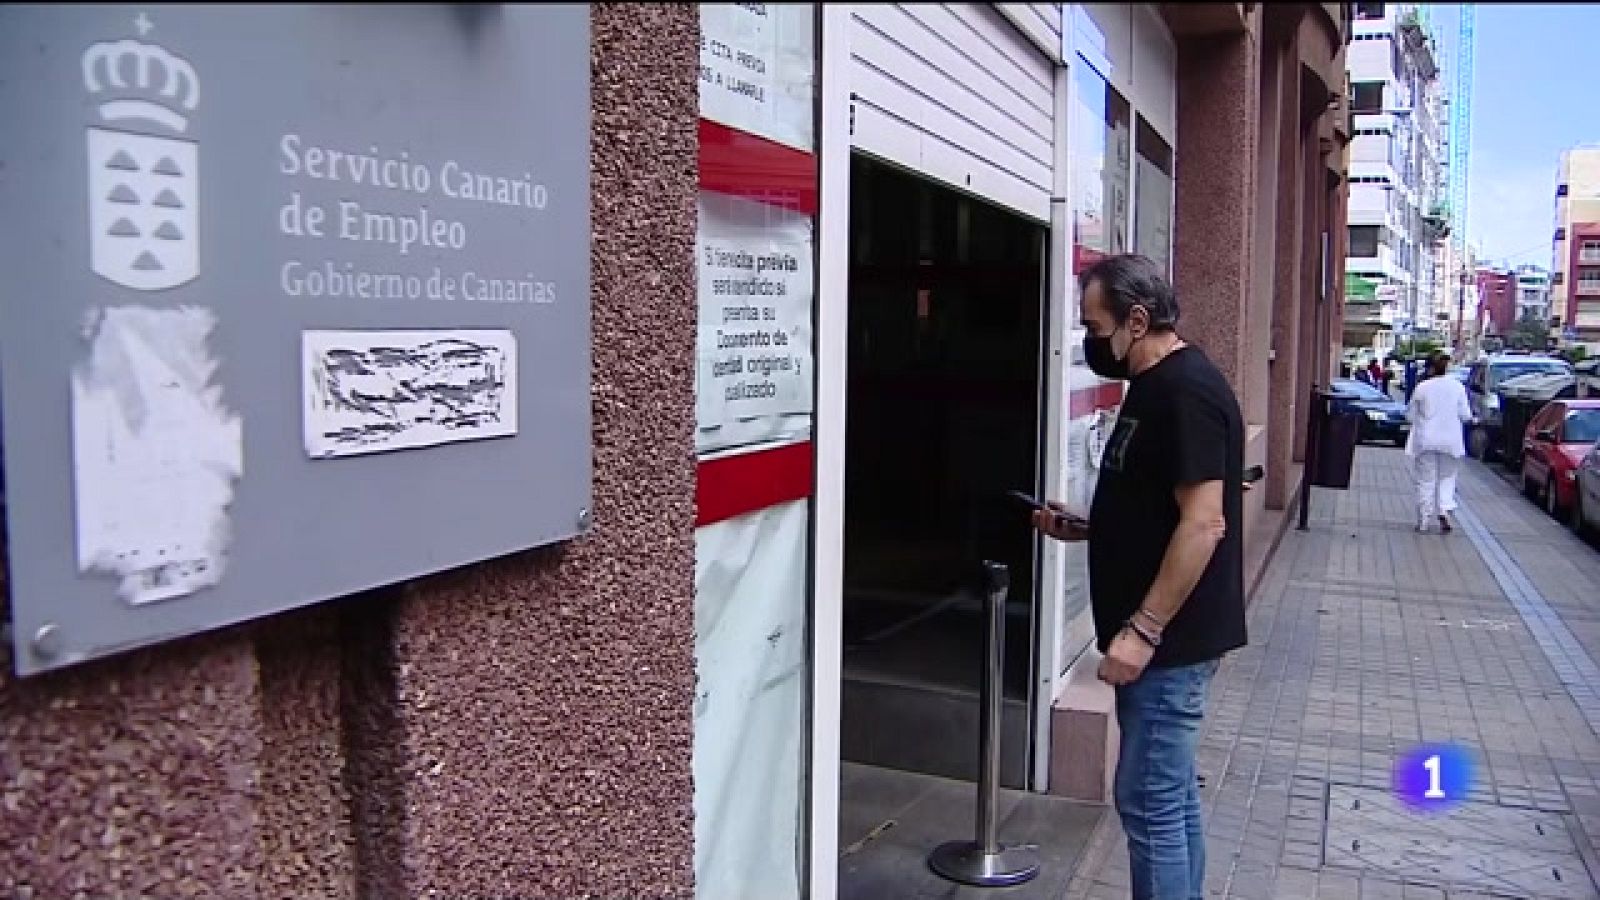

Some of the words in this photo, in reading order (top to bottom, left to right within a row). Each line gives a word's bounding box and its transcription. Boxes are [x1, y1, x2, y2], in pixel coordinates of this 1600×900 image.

[711, 40, 732, 60] CITA
[280, 134, 431, 193] Servicio
[440, 159, 548, 209] Canario
[280, 191, 324, 236] de
[339, 200, 466, 255] Empleo
[281, 261, 421, 299] Gobierno
[427, 266, 456, 301] de
[461, 270, 557, 304] Canarias
[773, 328, 789, 346] de
